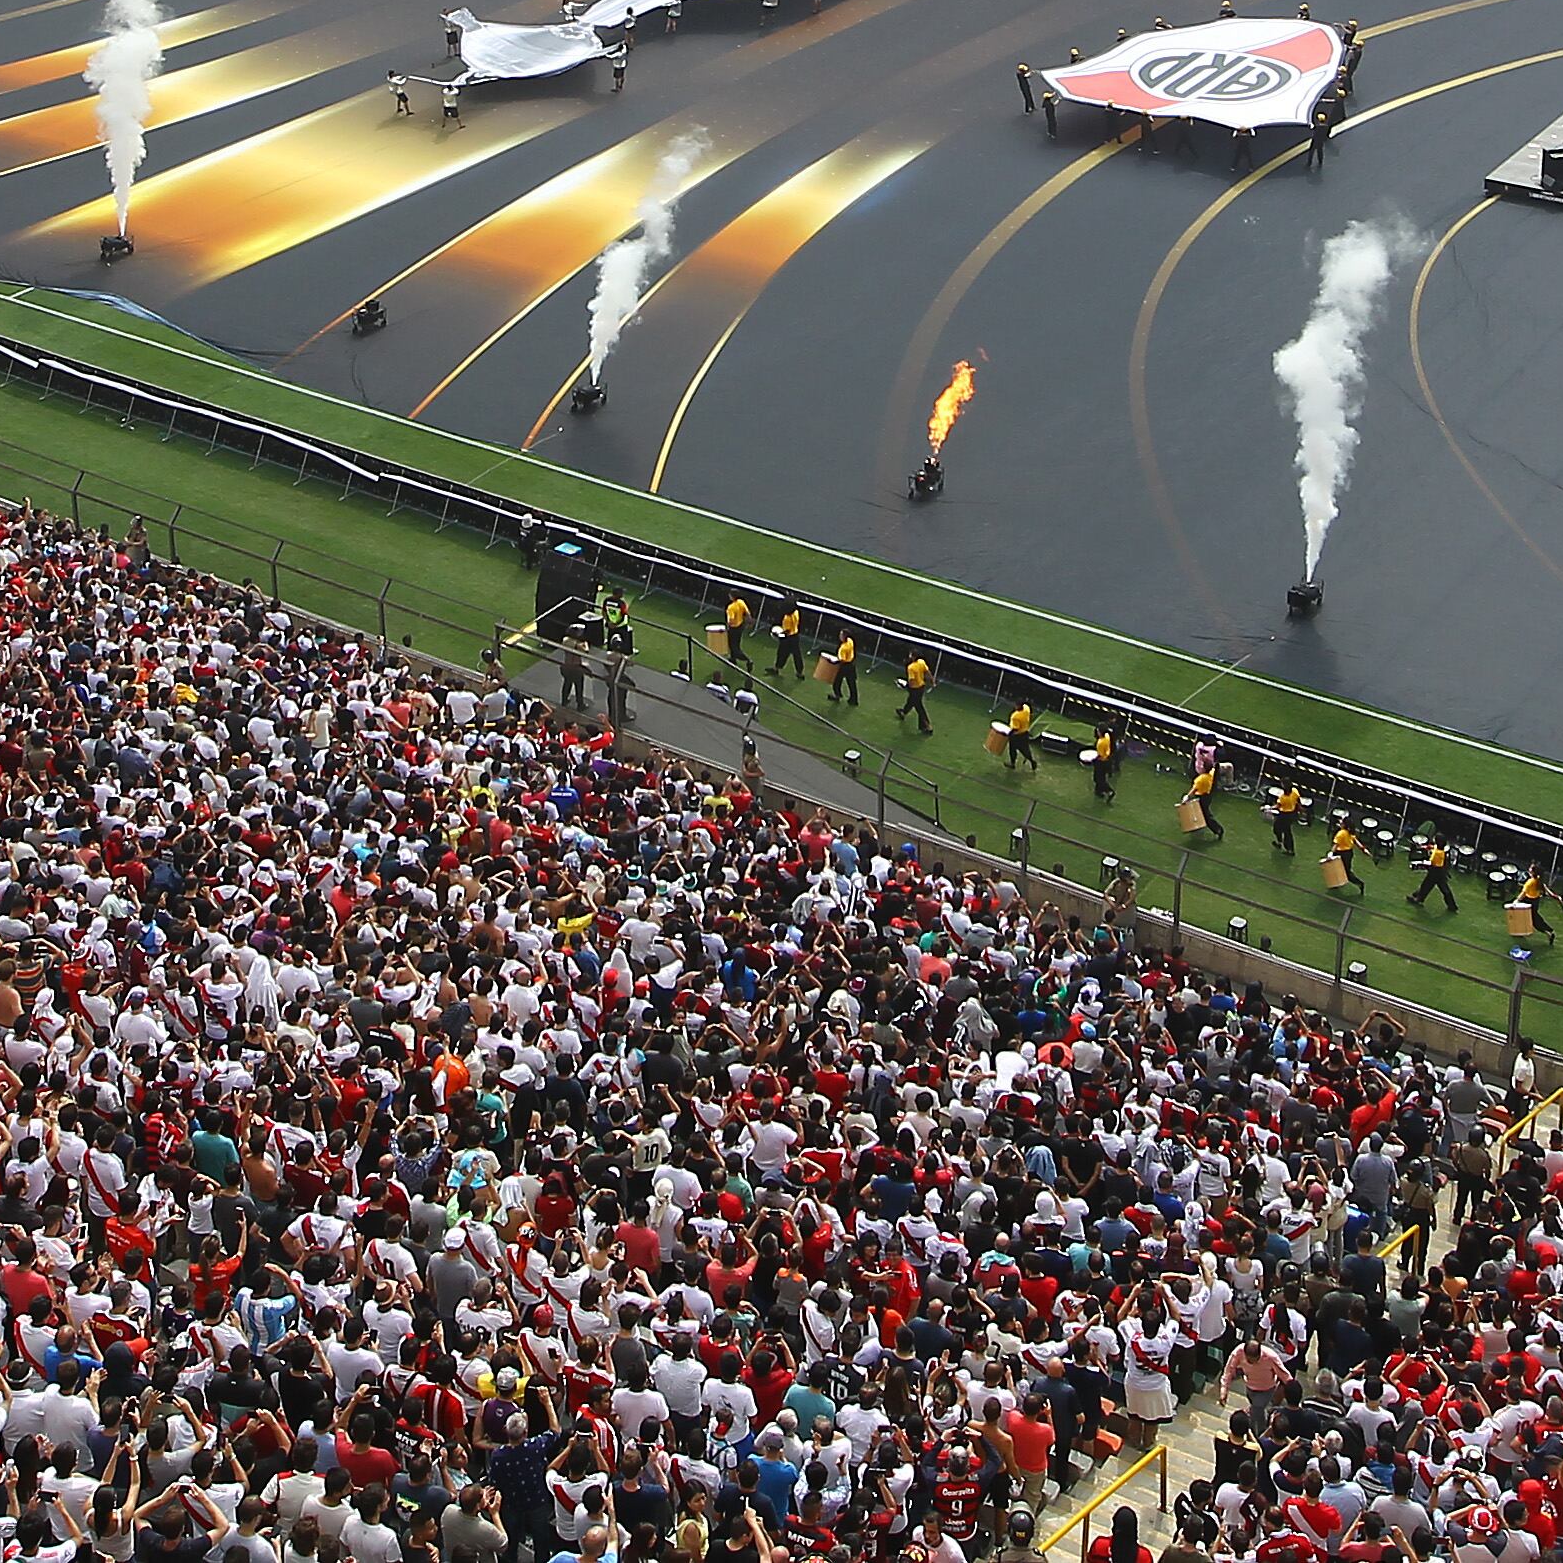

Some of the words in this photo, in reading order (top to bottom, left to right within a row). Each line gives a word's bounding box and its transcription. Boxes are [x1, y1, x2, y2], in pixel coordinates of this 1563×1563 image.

[644, 1143, 659, 1163] 10
[829, 1378, 848, 1400] 10
[951, 1500, 962, 1516] 9
